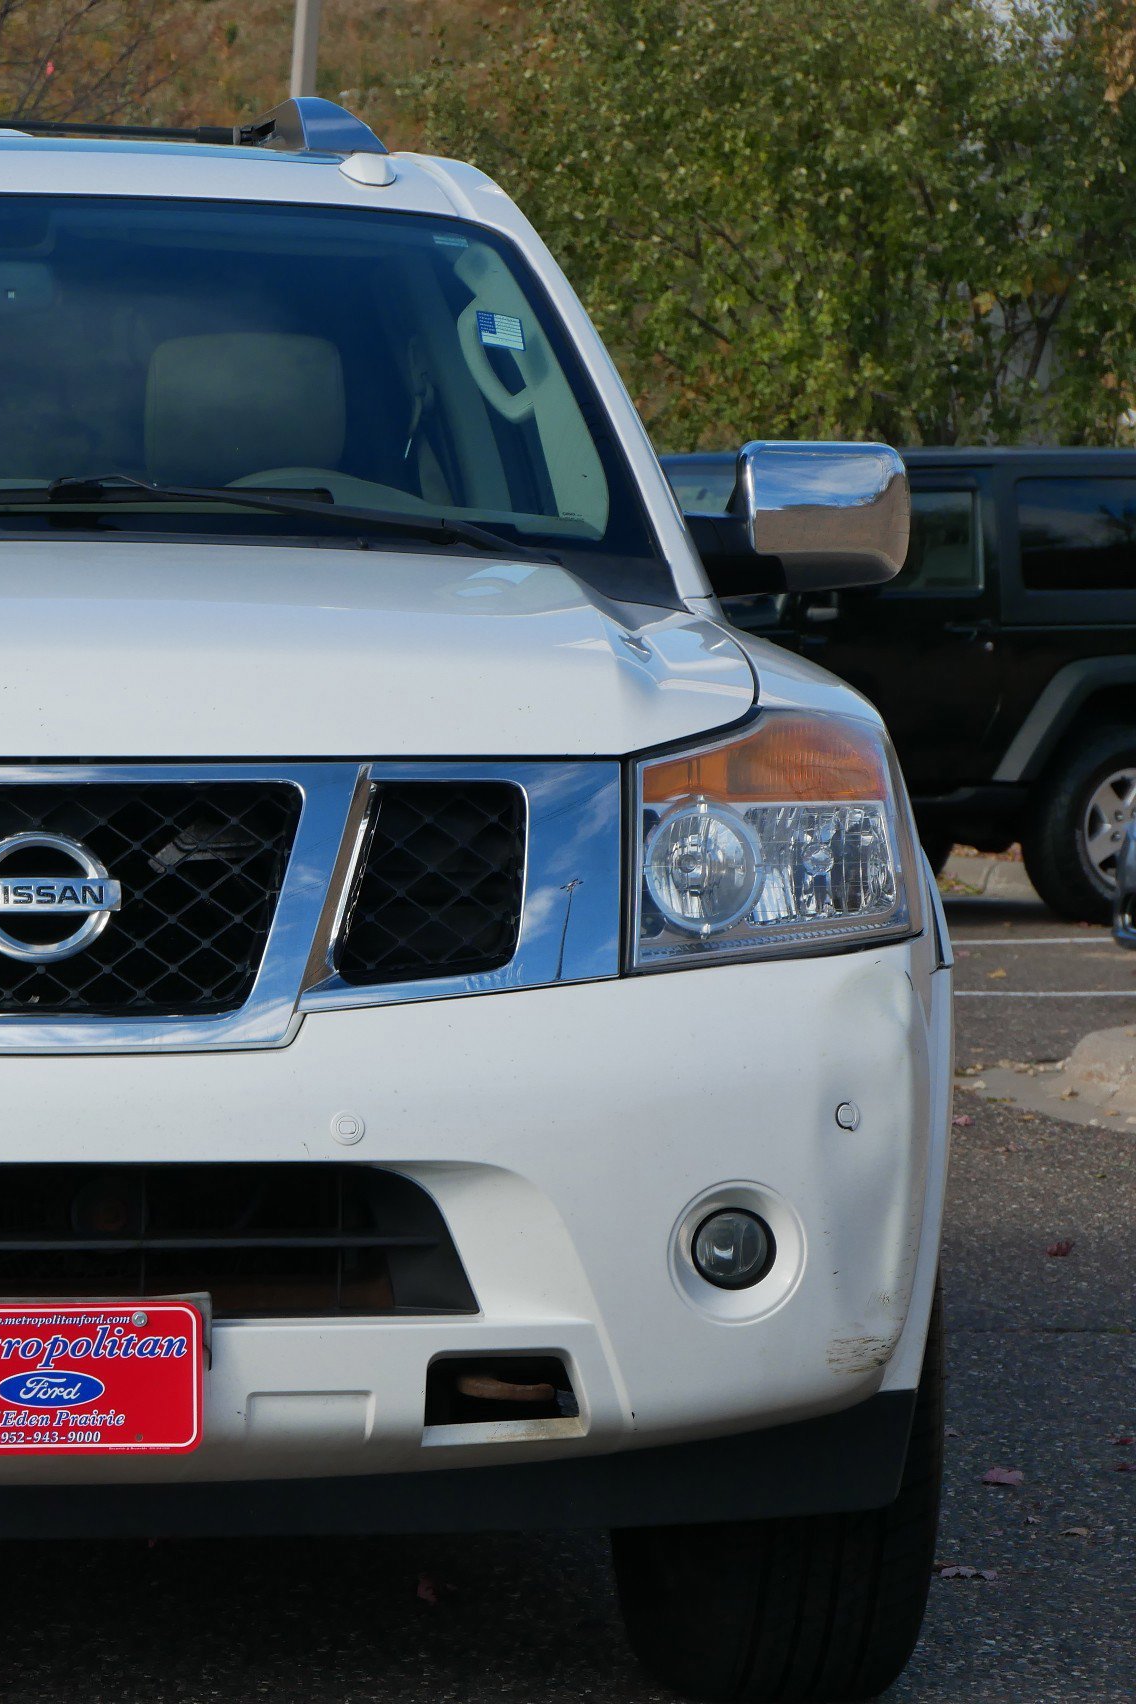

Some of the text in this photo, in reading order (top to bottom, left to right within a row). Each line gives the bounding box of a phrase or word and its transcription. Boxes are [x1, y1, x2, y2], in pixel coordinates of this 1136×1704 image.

[19, 1376, 82, 1400] Ford
[0, 1410, 51, 1427] Eden
[53, 1409, 126, 1427] Prairie
[0, 1431, 102, 1443] 952-943-9000
